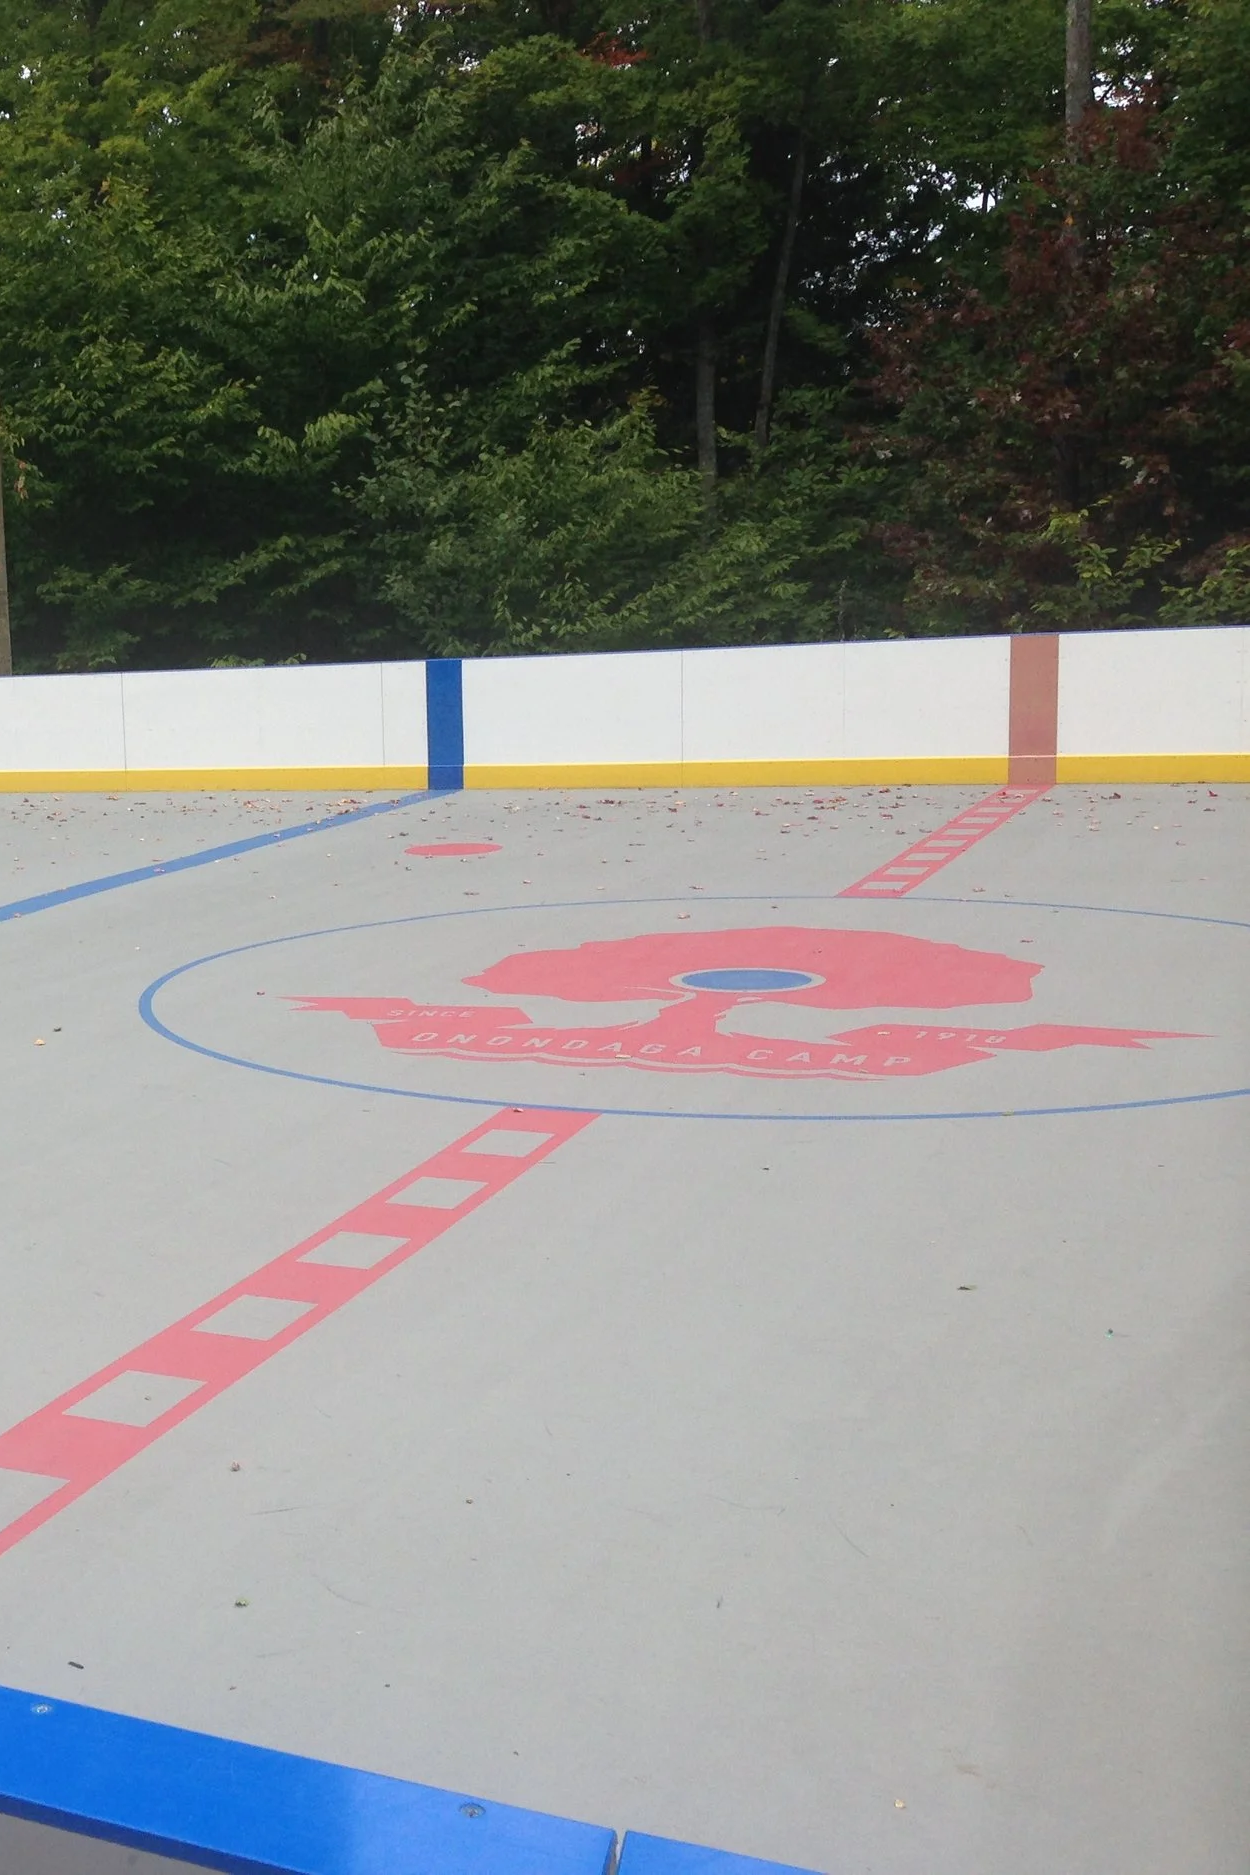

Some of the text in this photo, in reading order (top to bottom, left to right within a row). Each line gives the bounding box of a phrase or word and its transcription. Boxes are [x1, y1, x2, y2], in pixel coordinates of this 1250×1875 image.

[387, 1008, 477, 1018] SINCE
[915, 1030, 1007, 1044] 1918
[411, 1031, 912, 1067] ONONDAGA CAMP
